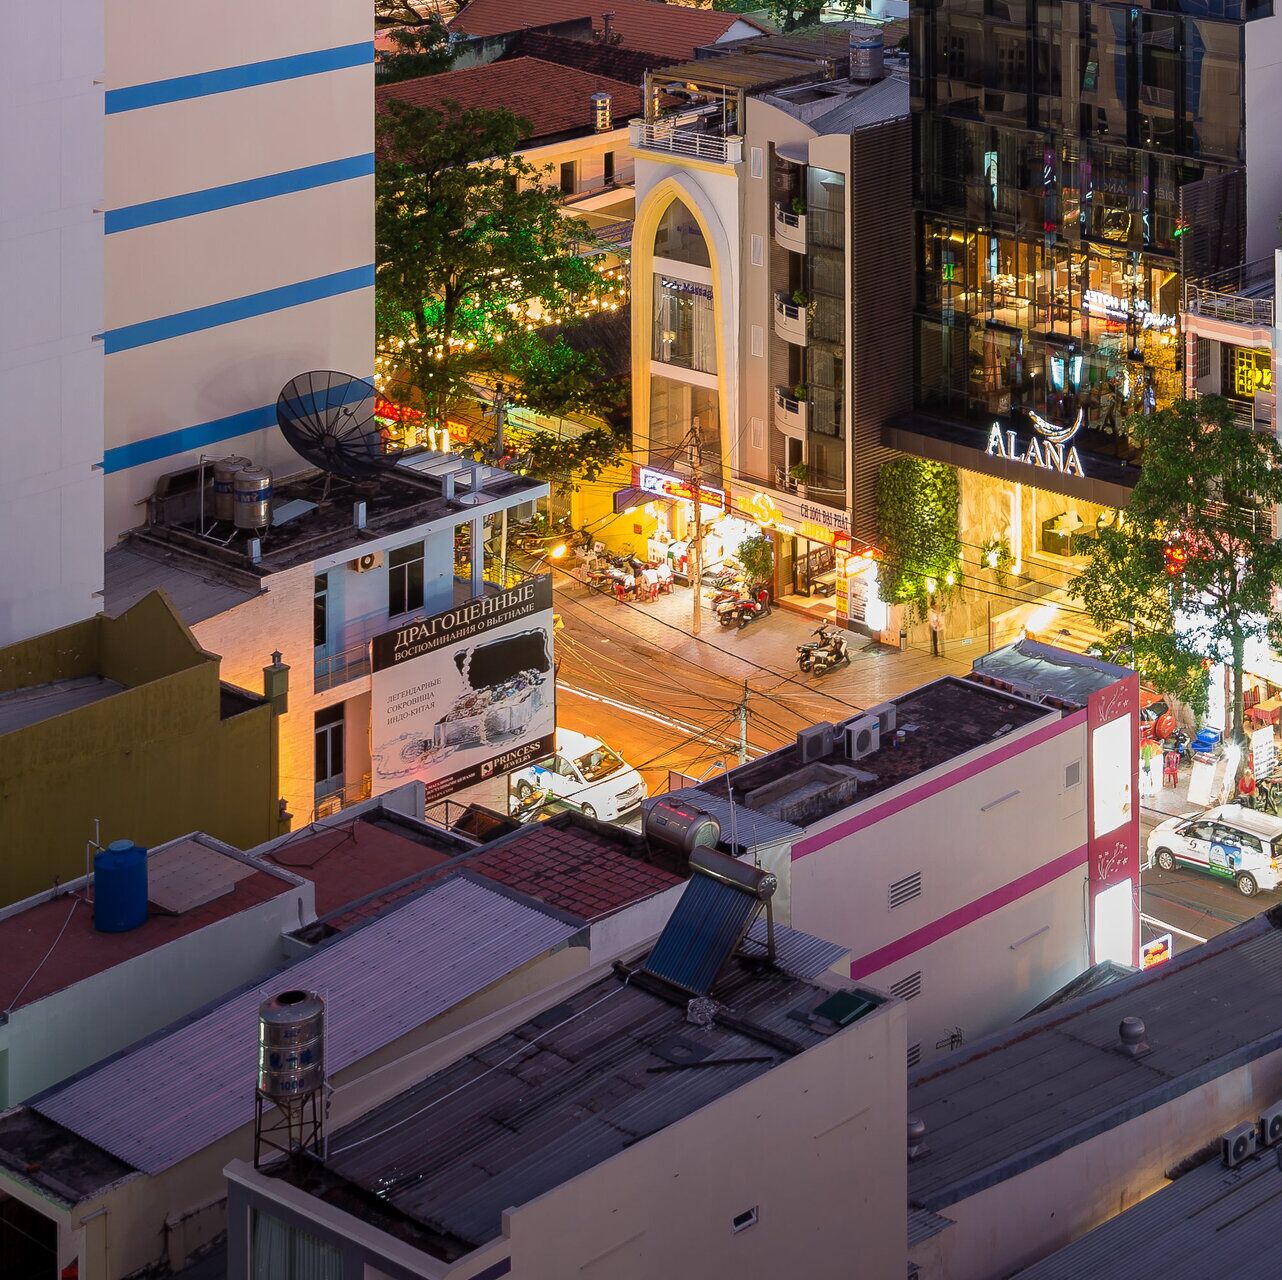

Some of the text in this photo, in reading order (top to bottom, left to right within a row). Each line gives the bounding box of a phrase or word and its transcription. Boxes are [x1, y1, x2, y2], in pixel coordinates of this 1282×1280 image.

[985, 421, 1086, 478] ALANA
[394, 584, 535, 651] ДРАГОЦЕННЫЕ
[395, 602, 535, 661] ВОСПОМИНАНИЯ О ВЬЕТНАМЕ
[387, 677, 442, 704] ЛЕГЕНДАРНЫЕ
[387, 691, 435, 715] СОКРОВИЩА
[387, 701, 435, 726] ИНДО-КИТАЯ
[494, 741, 541, 768] PRINCESS
[503, 754, 531, 771] JEWELRY
